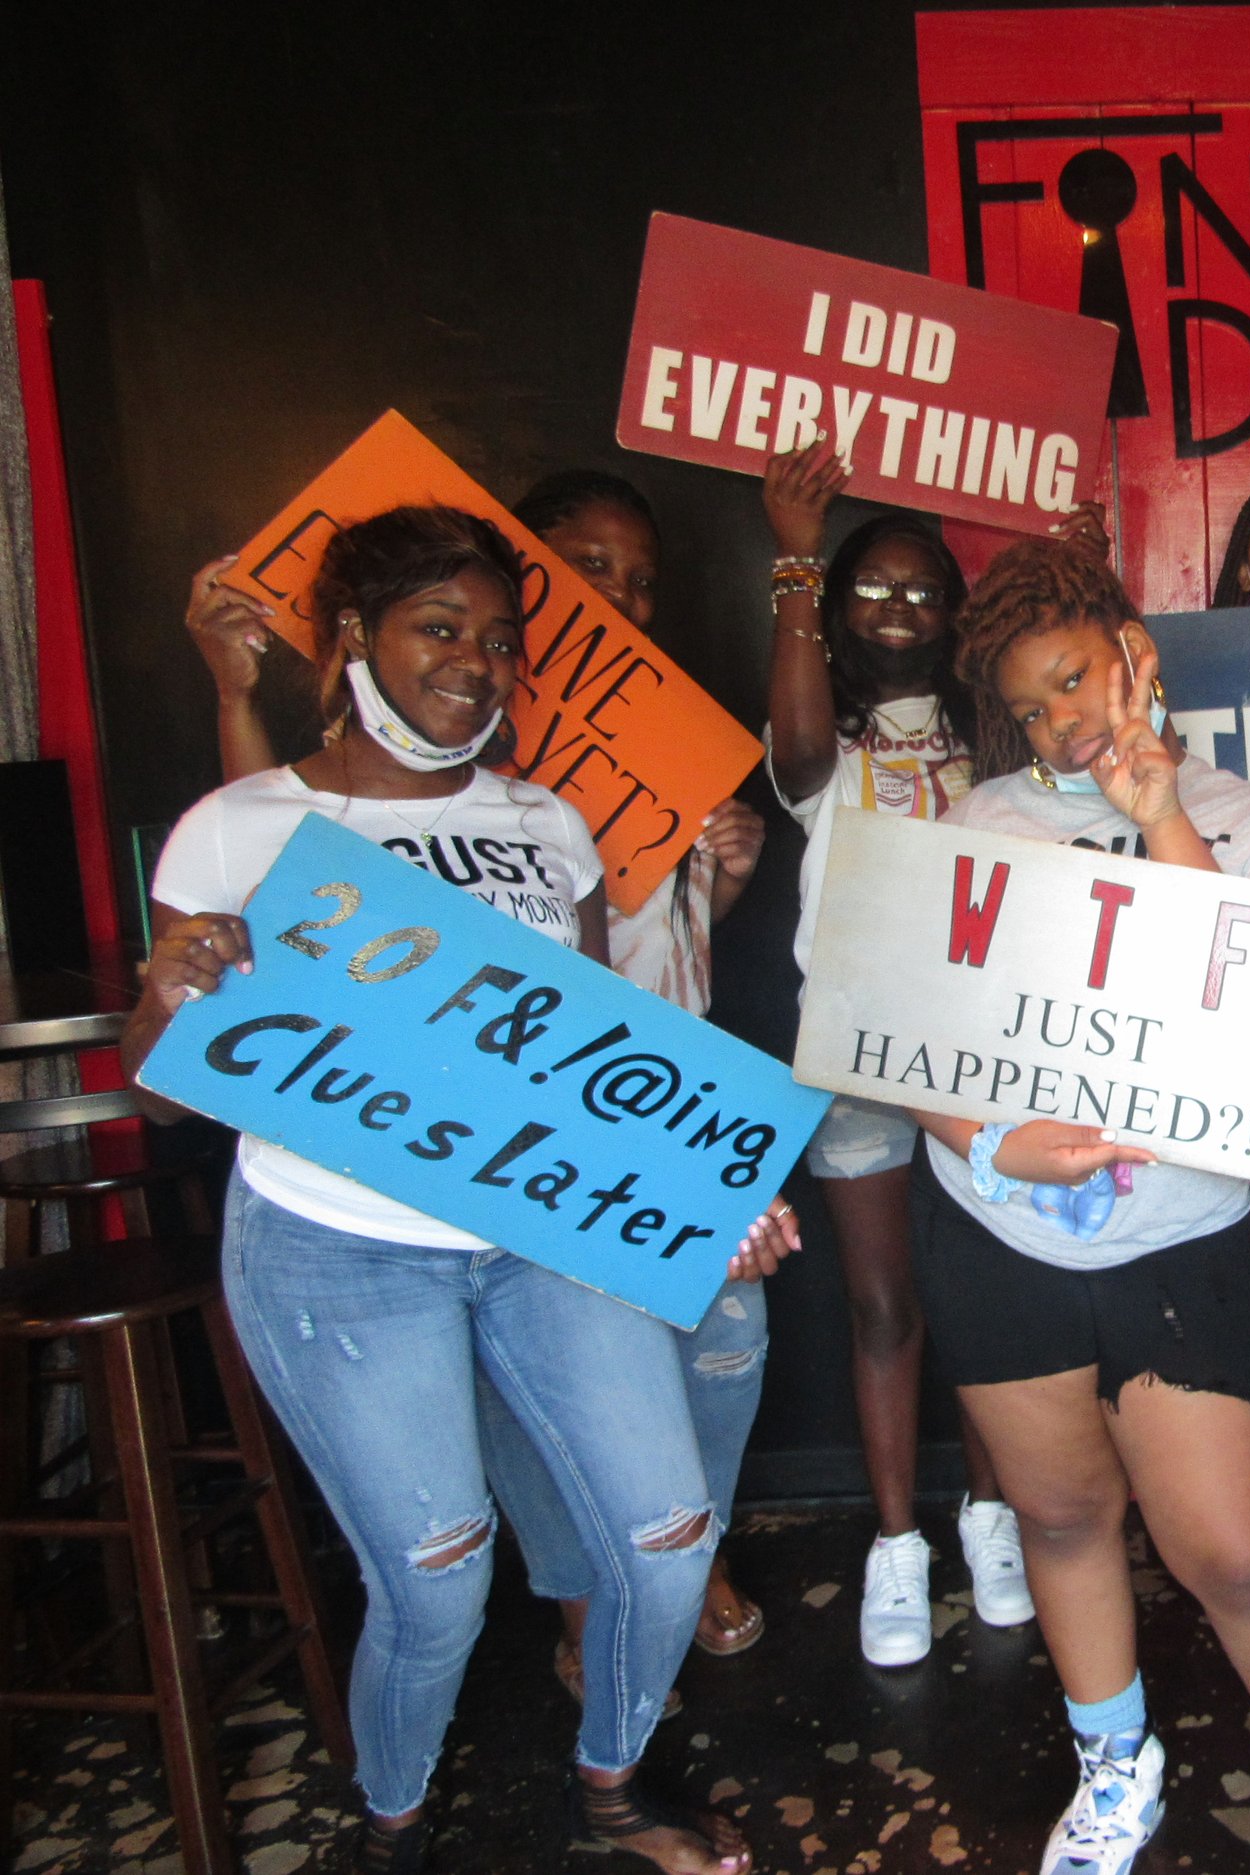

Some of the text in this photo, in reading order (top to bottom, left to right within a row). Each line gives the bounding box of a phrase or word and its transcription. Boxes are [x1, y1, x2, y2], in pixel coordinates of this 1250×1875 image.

[803, 291, 956, 384] I DID
[641, 345, 1079, 512] EVERYTHING
[531, 601, 664, 742] WE
[277, 882, 441, 984] 20
[1003, 993, 1163, 1064] JUST
[205, 1013, 714, 1260] Clues Later
